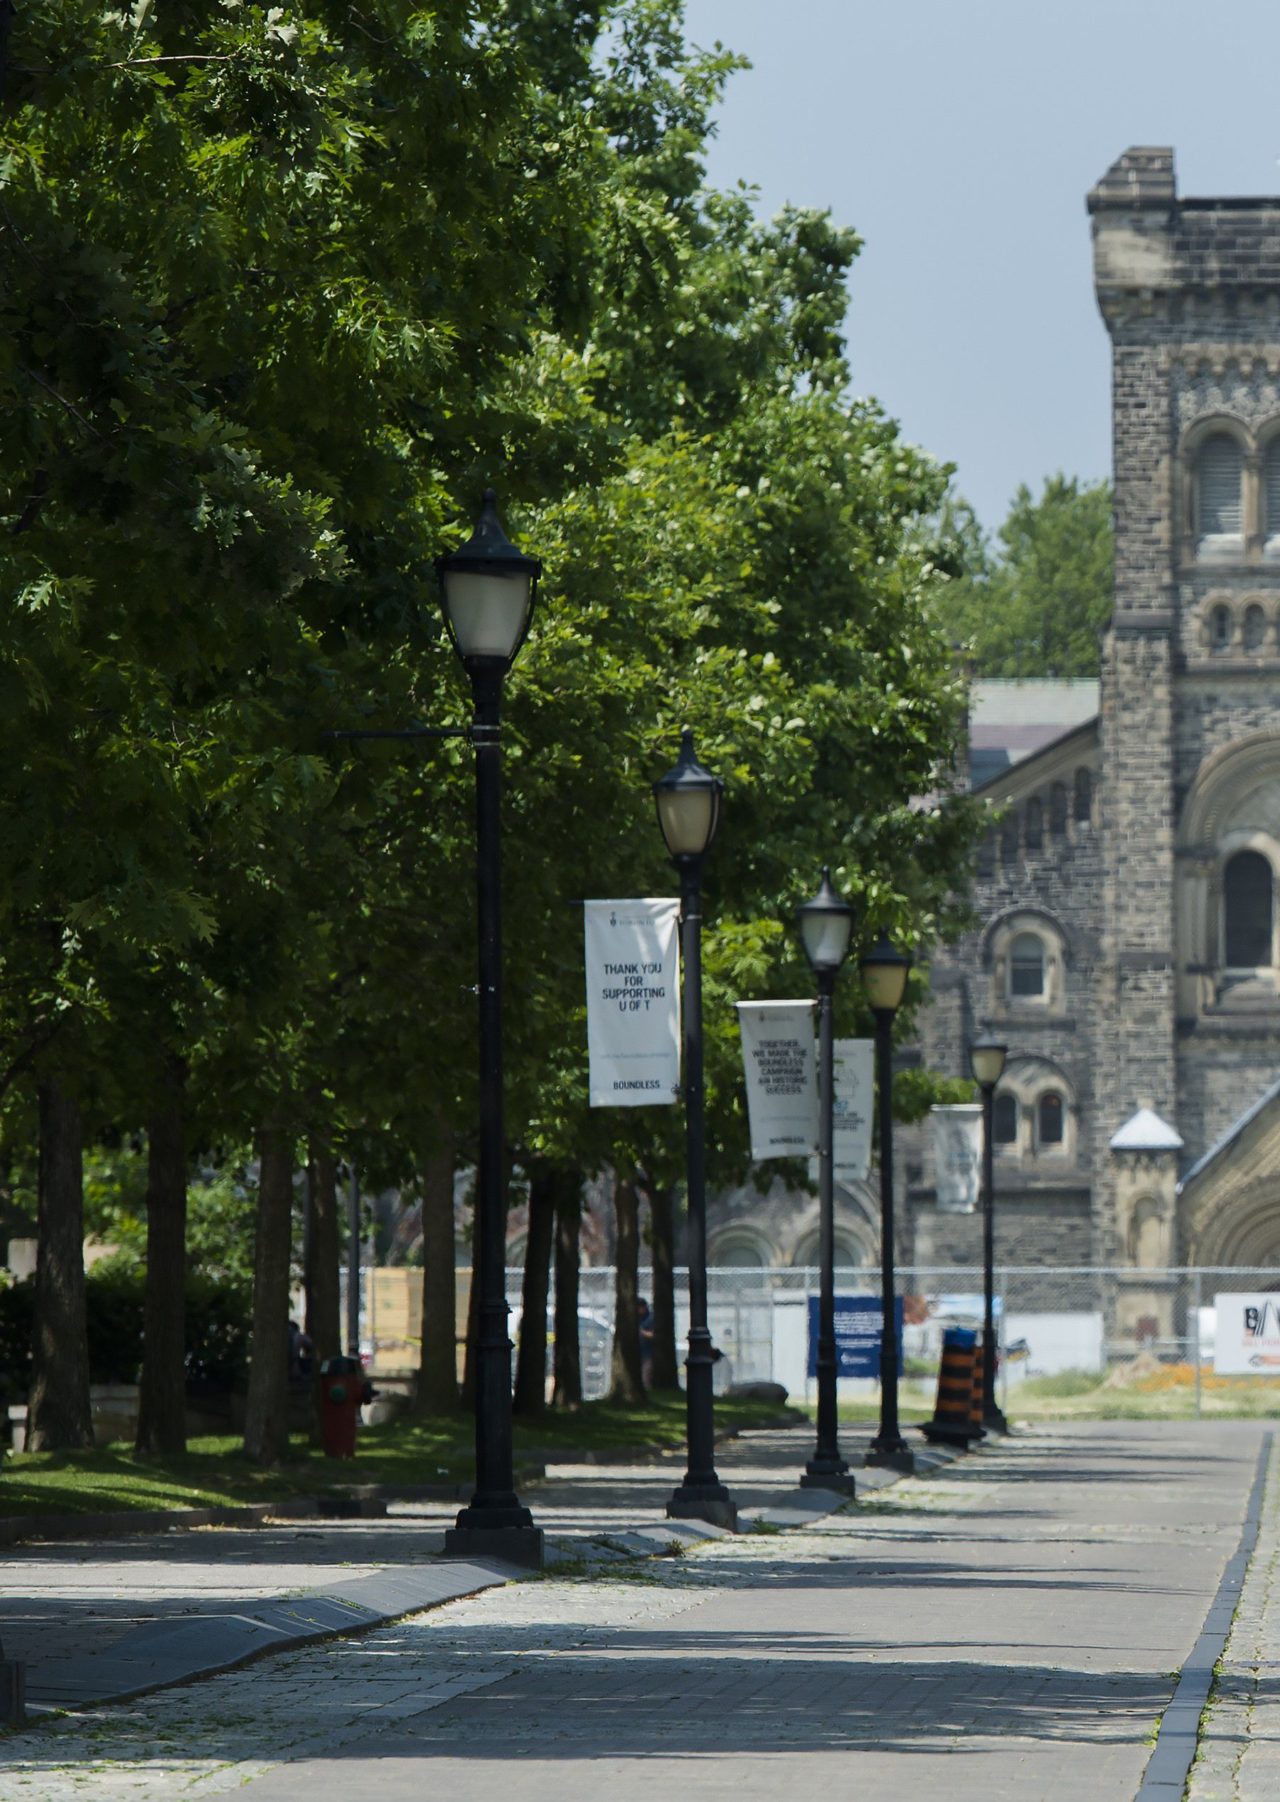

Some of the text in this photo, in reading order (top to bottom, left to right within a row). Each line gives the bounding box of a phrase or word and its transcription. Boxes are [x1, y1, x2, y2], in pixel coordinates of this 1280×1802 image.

[604, 962, 662, 975] THANK YOU
[624, 975, 643, 987] FOR
[602, 987, 665, 1000] SUPPORTING
[619, 1000, 650, 1012] U OF T
[613, 1080, 660, 1090] BOUNDLESS
